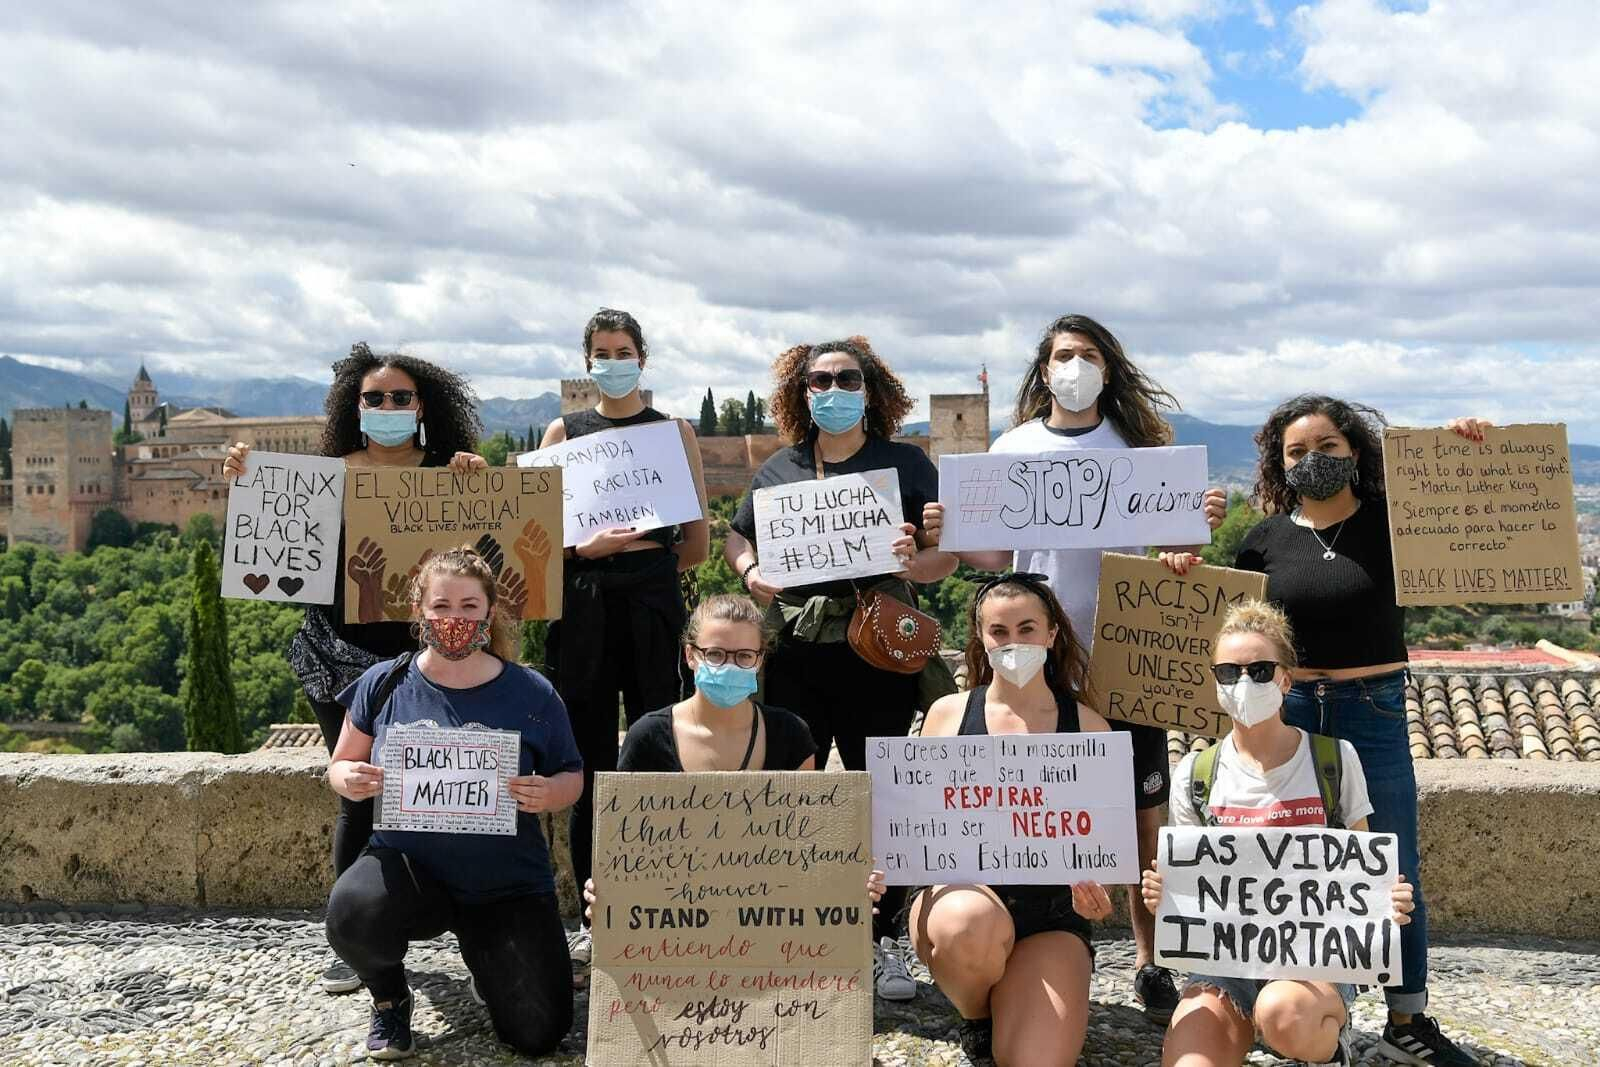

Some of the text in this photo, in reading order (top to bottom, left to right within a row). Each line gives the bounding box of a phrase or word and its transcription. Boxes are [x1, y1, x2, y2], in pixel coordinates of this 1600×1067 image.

[1432, 436, 1471, 460] time
[1479, 443, 1493, 457] is
[1500, 440, 1555, 462] always
[235, 465, 337, 498] LATINX
[355, 470, 551, 499] EL SILENCIO ES
[593, 468, 663, 495] RACISTA
[1396, 463, 1429, 481] right
[1436, 463, 1450, 477] to
[1456, 463, 1473, 477] do
[1480, 461, 1513, 477] what
[1518, 465, 1530, 475] is
[774, 486, 877, 514] TU LUCHA
[1092, 457, 1205, 529] Racismo
[1466, 481, 1505, 494] Luther
[1509, 480, 1537, 496] King
[262, 491, 311, 519] FOR
[384, 496, 520, 524] VIOLENCIA!
[575, 503, 655, 529] TAMBIEN
[1464, 503, 1478, 515] es
[1484, 502, 1497, 514] el
[235, 514, 324, 546] BLACK
[390, 522, 502, 534] BLACK LIVES MATTER
[770, 508, 892, 539] ES MI LUCHA
[1396, 518, 1556, 538] adecuado para hacer lo
[235, 544, 322, 572] LIVES
[780, 535, 872, 572] #BLM
[1401, 567, 1569, 589] BLACK LIVES MATTER!
[1115, 579, 1245, 616] RACISM
[1159, 612, 1205, 632] isn't
[1101, 623, 1212, 657] CONTROVER
[1128, 652, 1205, 686] UNLESS
[1142, 683, 1194, 700] you're
[1109, 692, 1229, 734] RACIST
[404, 747, 498, 770] BLACK LIVES
[876, 741, 890, 760] Si
[958, 742, 987, 767] que
[1001, 739, 1016, 757] tu
[1027, 739, 1106, 758] mascarilla
[894, 764, 933, 785] hace
[949, 767, 977, 790] que
[412, 779, 489, 807] MATTER
[600, 779, 850, 816] i understand
[611, 811, 824, 846] that i will
[889, 810, 1092, 838] intenta ser NEGRO
[1217, 815, 1235, 824] ore
[1267, 808, 1292, 820] love
[1296, 805, 1324, 816] more
[603, 852, 702, 873] never
[885, 842, 1118, 871] en Los Estados Unidos
[1167, 833, 1392, 876] LAS VIDAS
[1197, 875, 1371, 916] NEGRAS
[606, 905, 864, 929] I STAND WITH YOU.
[615, 935, 834, 966] entiendo que
[1159, 915, 1392, 984] IMPORTAN!
[624, 972, 700, 992] nunca
[706, 970, 730, 991] lo
[608, 996, 828, 1025] pero estoy con
[648, 1024, 776, 1052] vosotros
